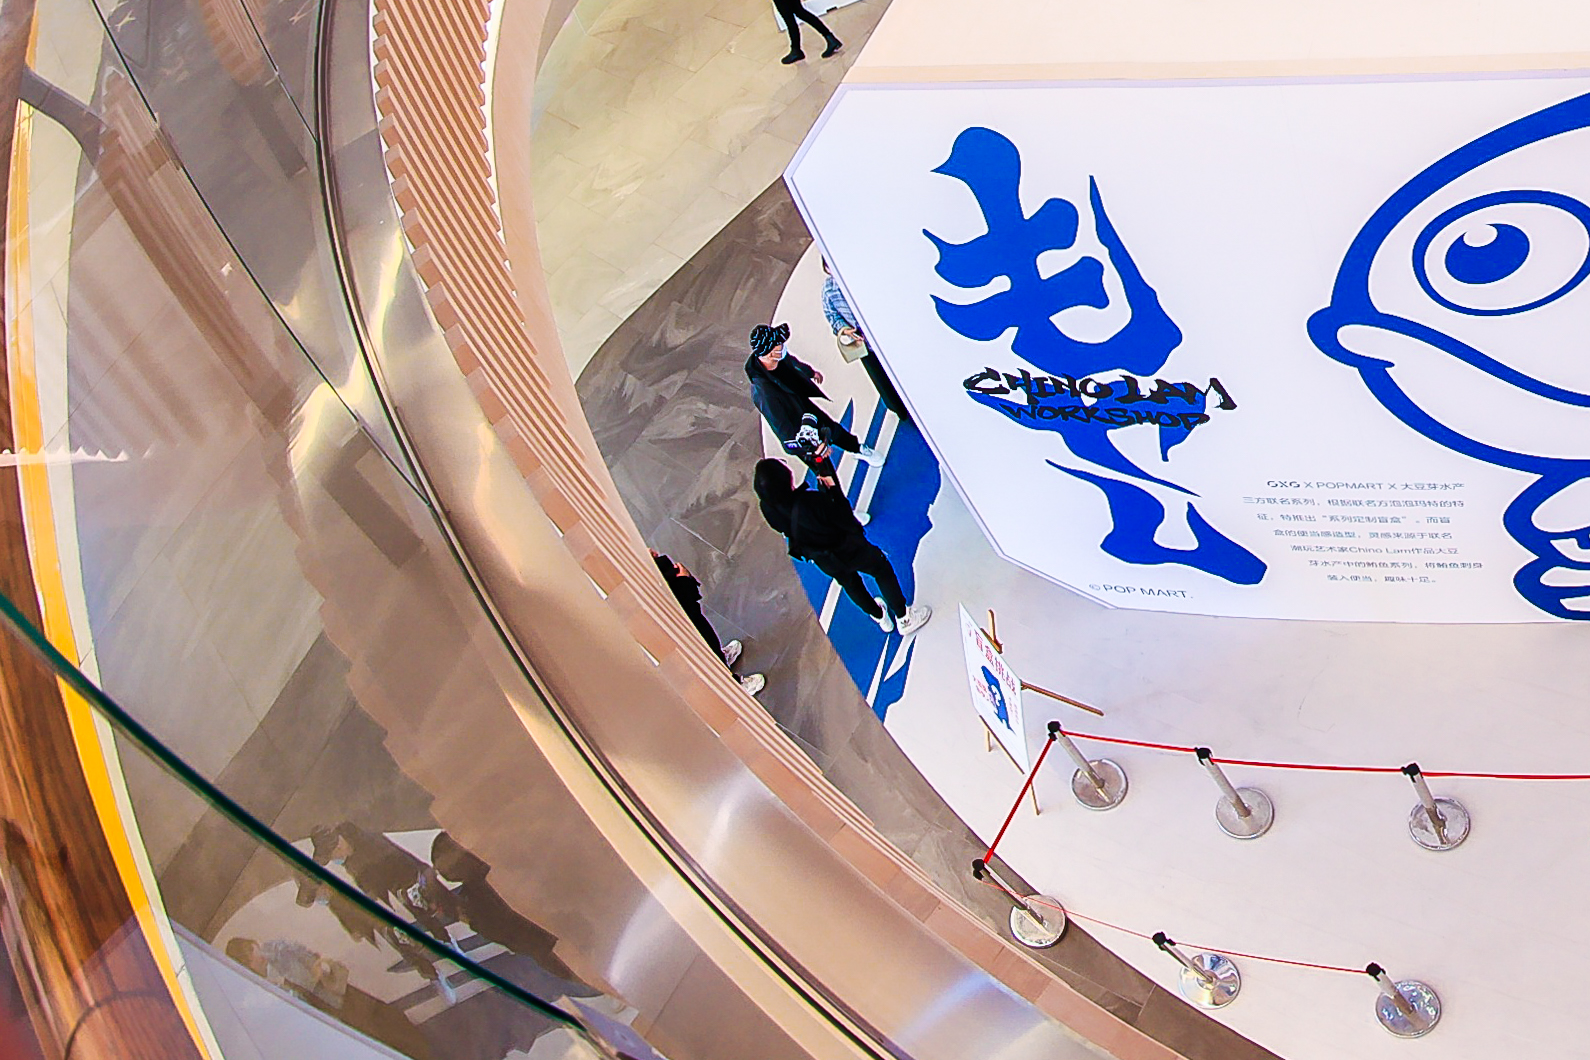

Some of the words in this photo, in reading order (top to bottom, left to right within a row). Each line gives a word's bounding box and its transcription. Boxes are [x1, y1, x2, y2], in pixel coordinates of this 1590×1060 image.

[962, 366, 1114, 406] CHINO
[1114, 373, 1238, 411] LAM
[999, 404, 1211, 431] WORKSHOP
[1266, 480, 1301, 489] GXG
[1316, 481, 1384, 491] POPMART
[1400, 482, 1465, 491] 大豆芽水产
[1102, 584, 1137, 595] POP
